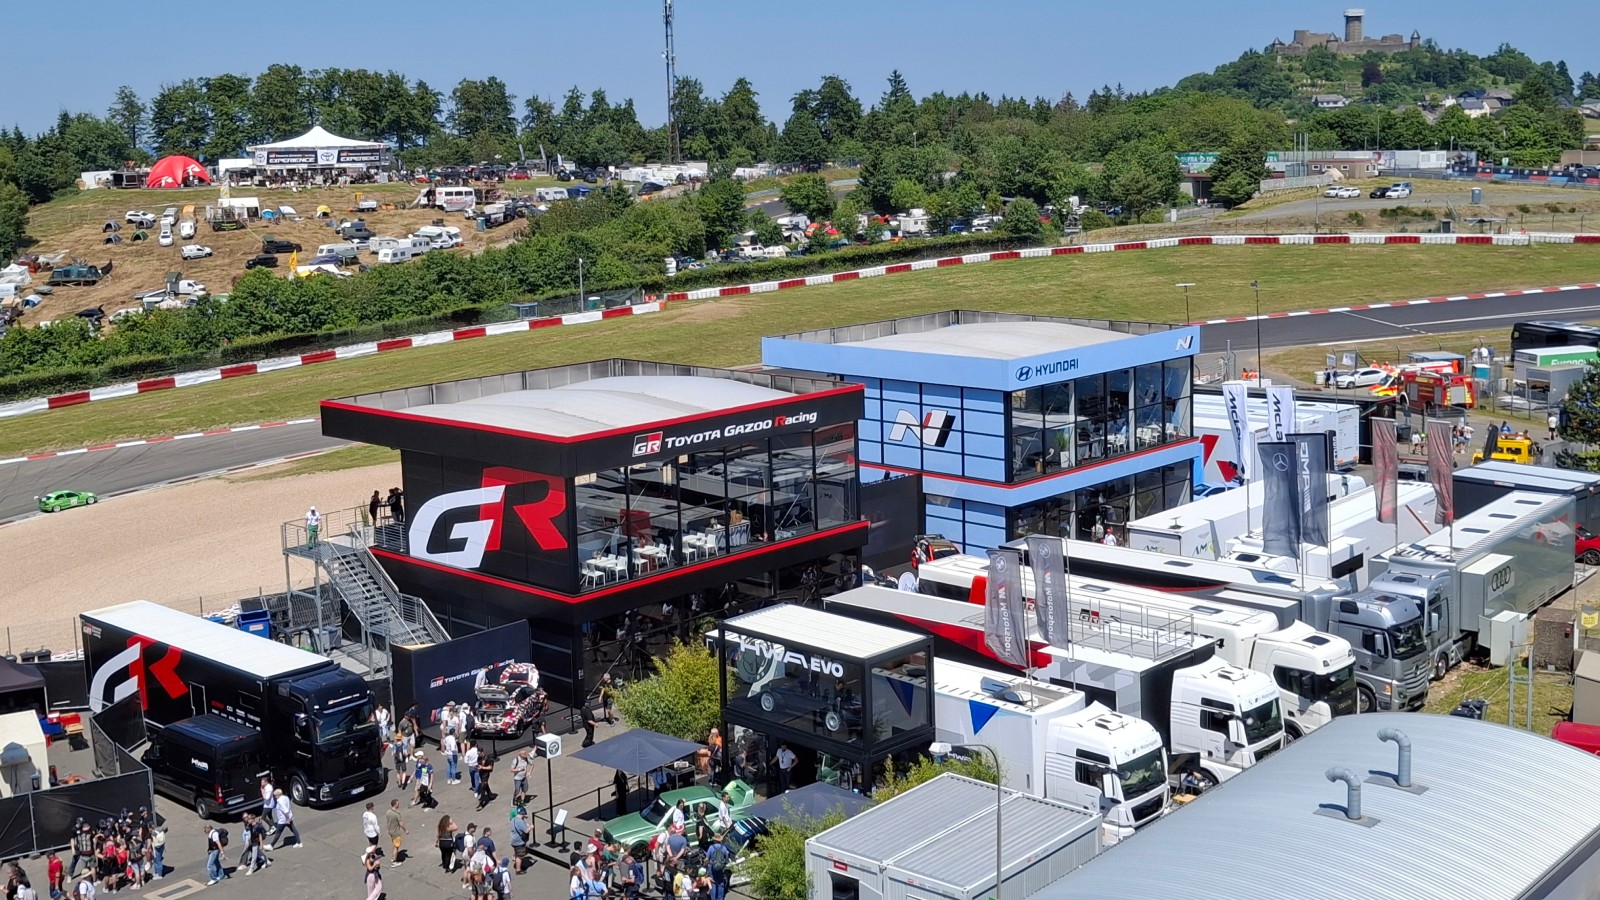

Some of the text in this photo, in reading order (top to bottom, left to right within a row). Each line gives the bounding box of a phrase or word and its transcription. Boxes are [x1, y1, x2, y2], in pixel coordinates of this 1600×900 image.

[1035, 358, 1079, 377] HYUNDAI
[634, 411, 818, 455] GR TOYOTA GAZOO Racing
[409, 465, 568, 569] GR
[810, 656, 844, 678] EVO
[445, 673, 470, 684] TOYOTA
